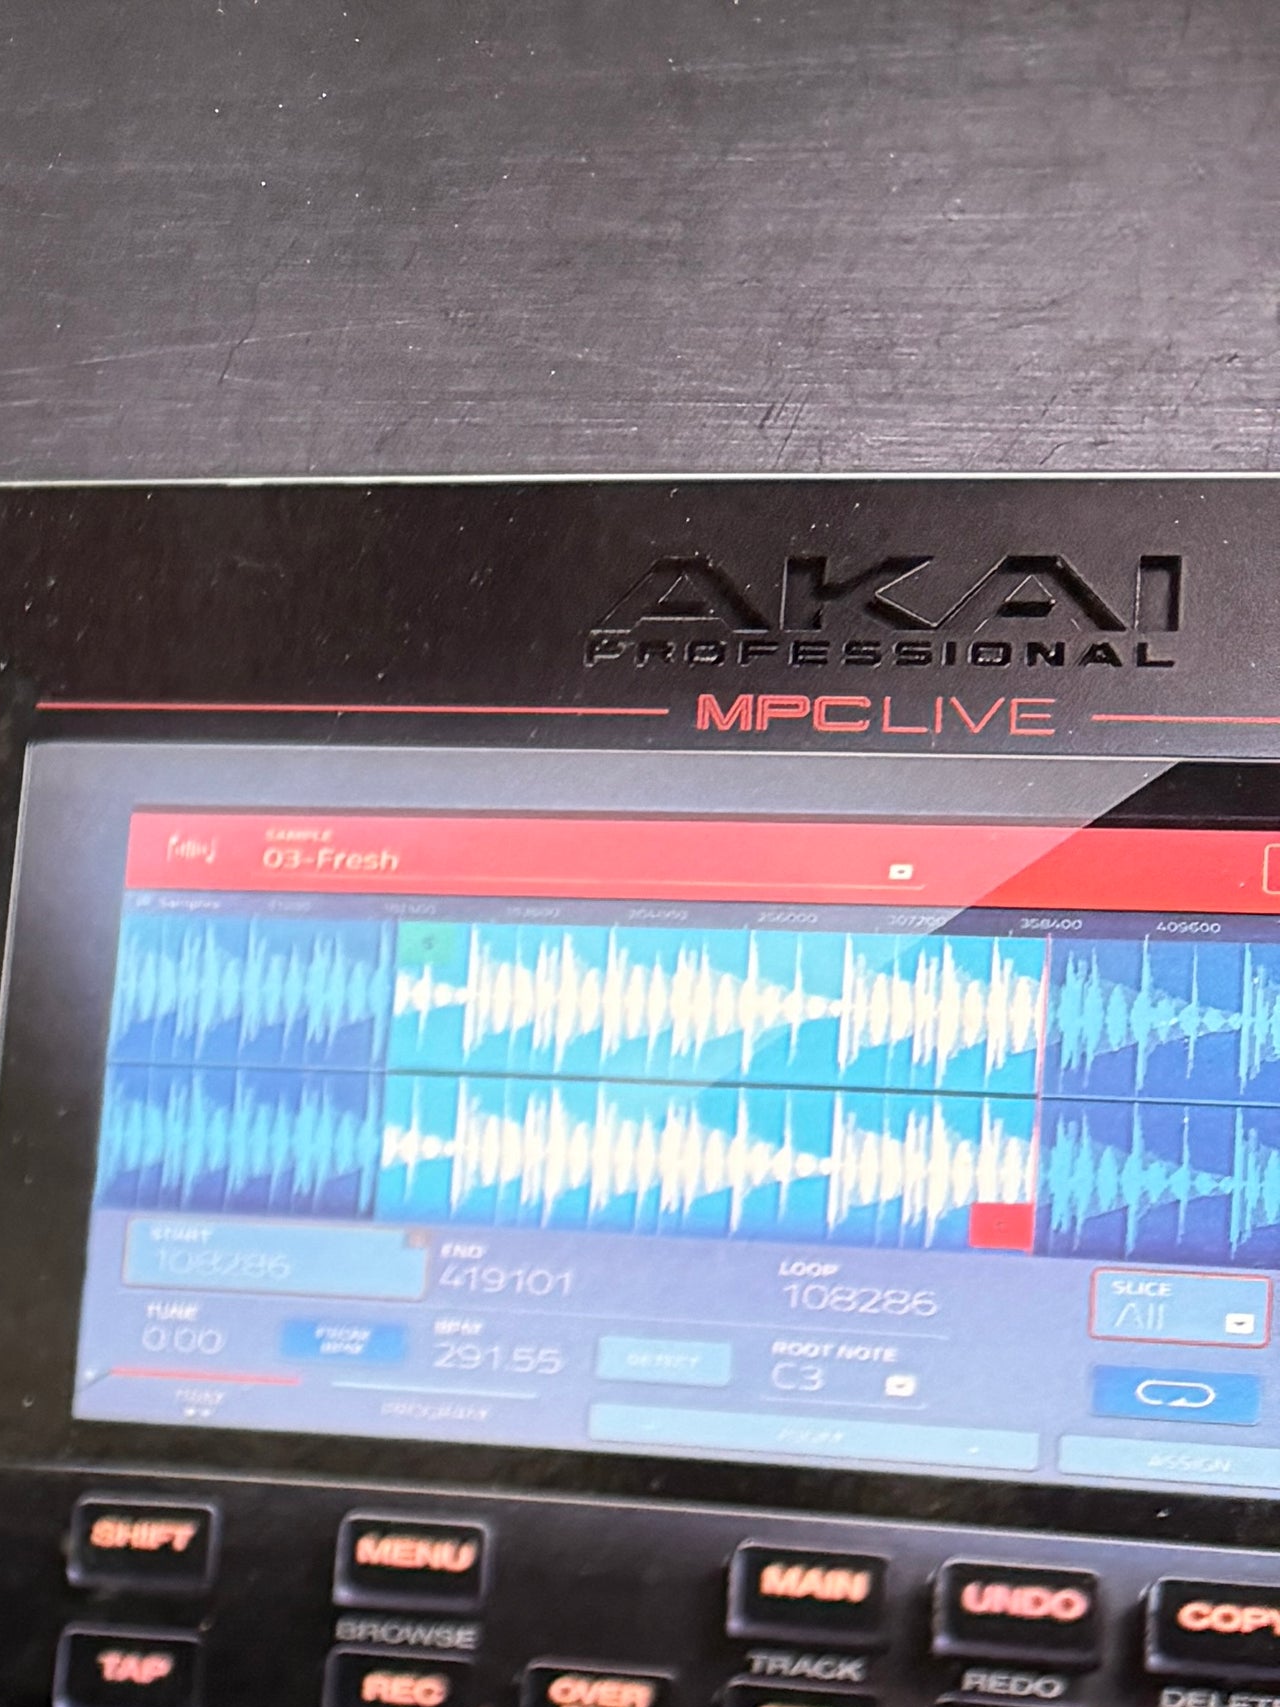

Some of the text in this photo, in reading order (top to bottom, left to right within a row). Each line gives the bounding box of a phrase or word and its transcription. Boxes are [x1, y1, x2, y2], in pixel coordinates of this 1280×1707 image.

[590, 553, 1183, 633] AKAI
[583, 637, 1176, 670] PROFESSIONAL
[263, 847, 400, 874] 03-Fresh
[439, 1265, 576, 1298] 419101
[777, 1260, 841, 1279] LOOP
[782, 1282, 940, 1319] 108286
[1110, 1279, 1173, 1298] SLICE
[770, 1361, 826, 1392] C3
[89, 1515, 199, 1554] SHIFT
[354, 1531, 479, 1574] MENU
[759, 1560, 874, 1605] MAIN
[960, 1580, 1090, 1624] UNDO
[335, 1616, 480, 1651] BROWSE
[95, 1650, 175, 1685] TAP
[746, 1651, 869, 1683] TRACK
[961, 1668, 1066, 1700] REDO
